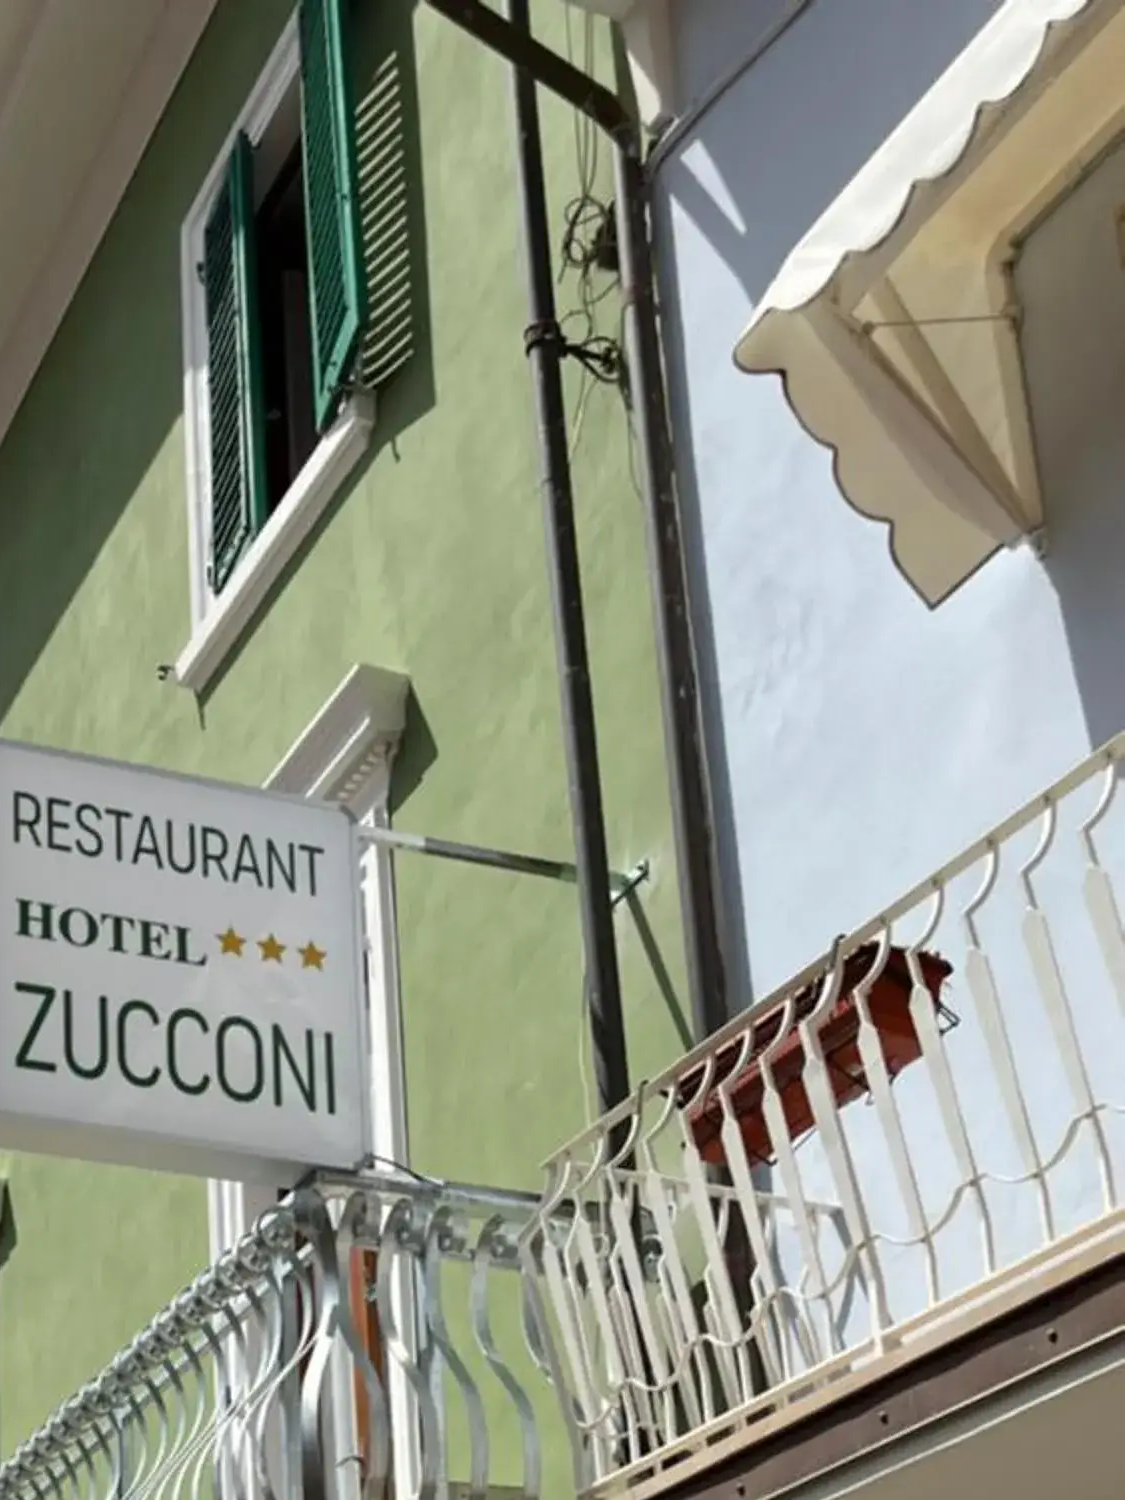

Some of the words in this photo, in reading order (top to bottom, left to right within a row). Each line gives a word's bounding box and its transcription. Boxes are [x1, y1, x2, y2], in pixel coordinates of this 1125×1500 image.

[12, 791, 325, 897] RESTAURANT
[15, 897, 208, 967] HOTEL
[14, 982, 336, 1115] ZUCCONI
